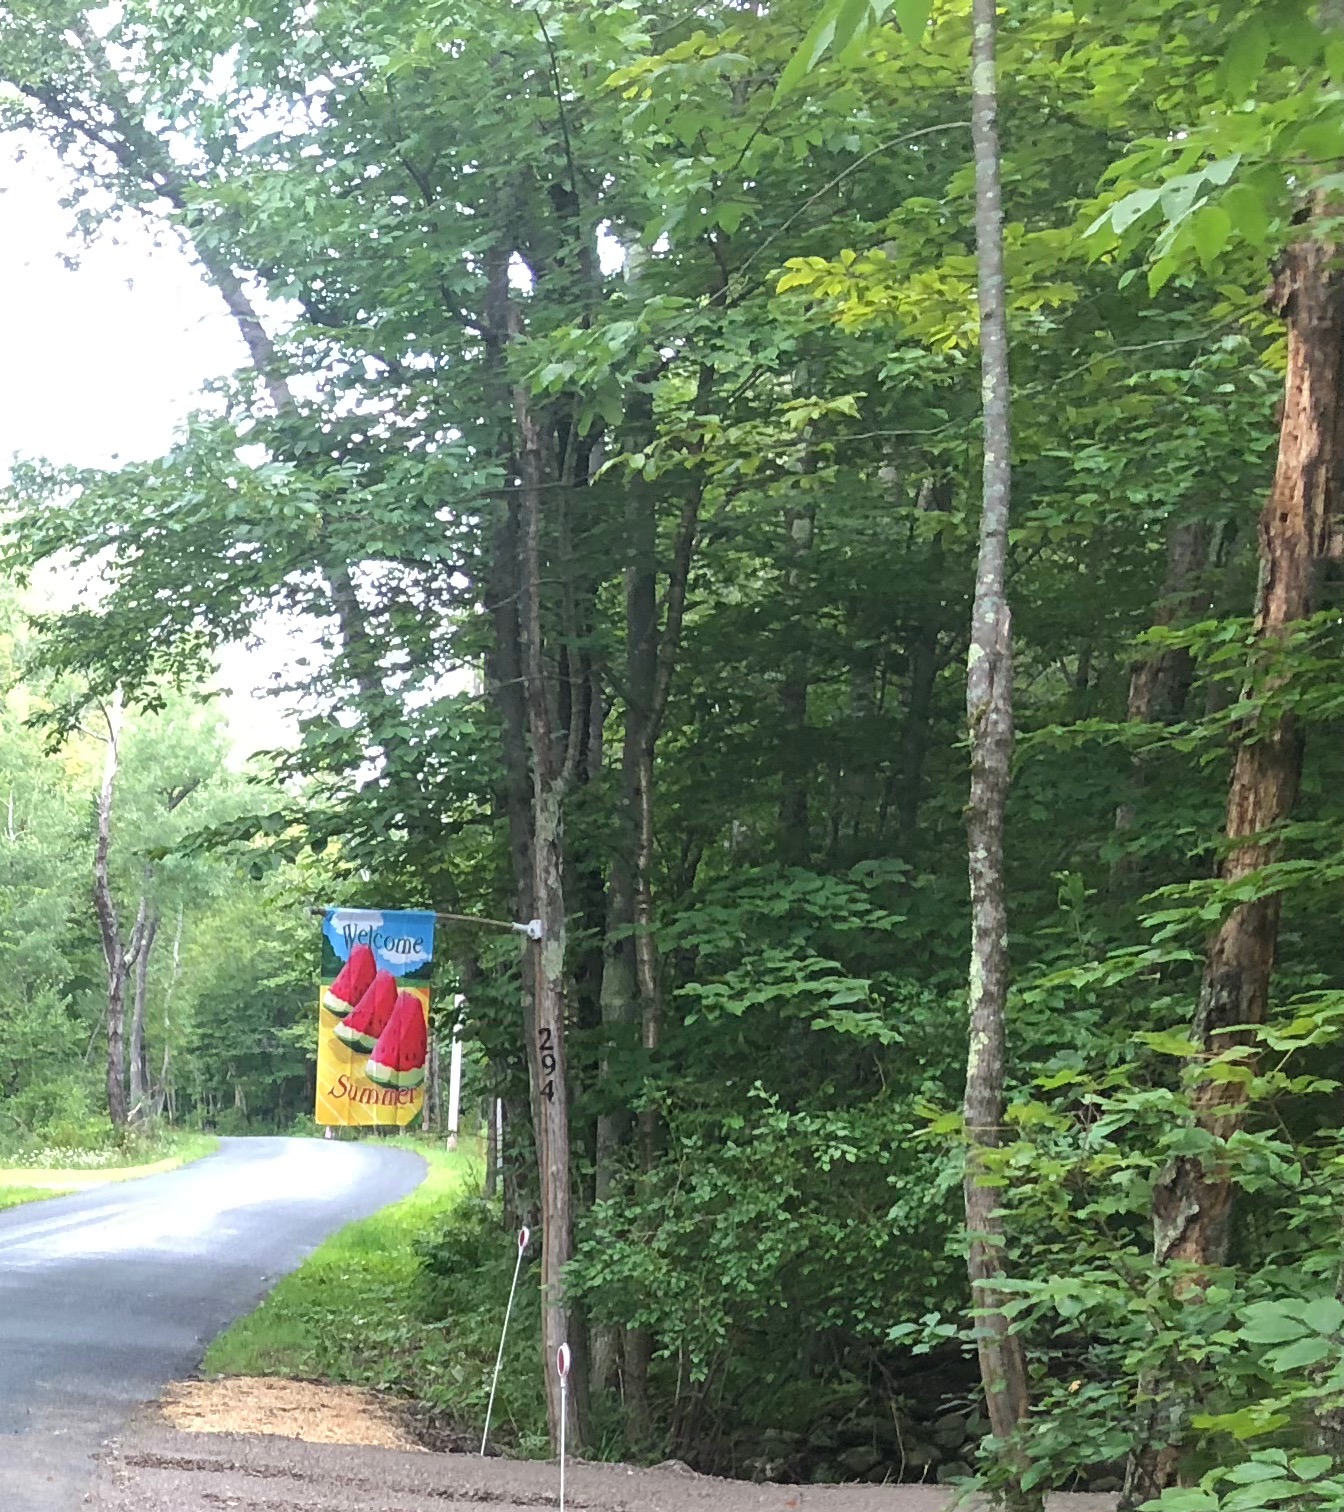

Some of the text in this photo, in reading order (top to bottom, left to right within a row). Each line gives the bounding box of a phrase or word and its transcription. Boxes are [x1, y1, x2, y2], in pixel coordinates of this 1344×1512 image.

[343, 923, 424, 954] Welcome
[538, 1027, 556, 1103] 294
[327, 1074, 417, 1106] Summer
